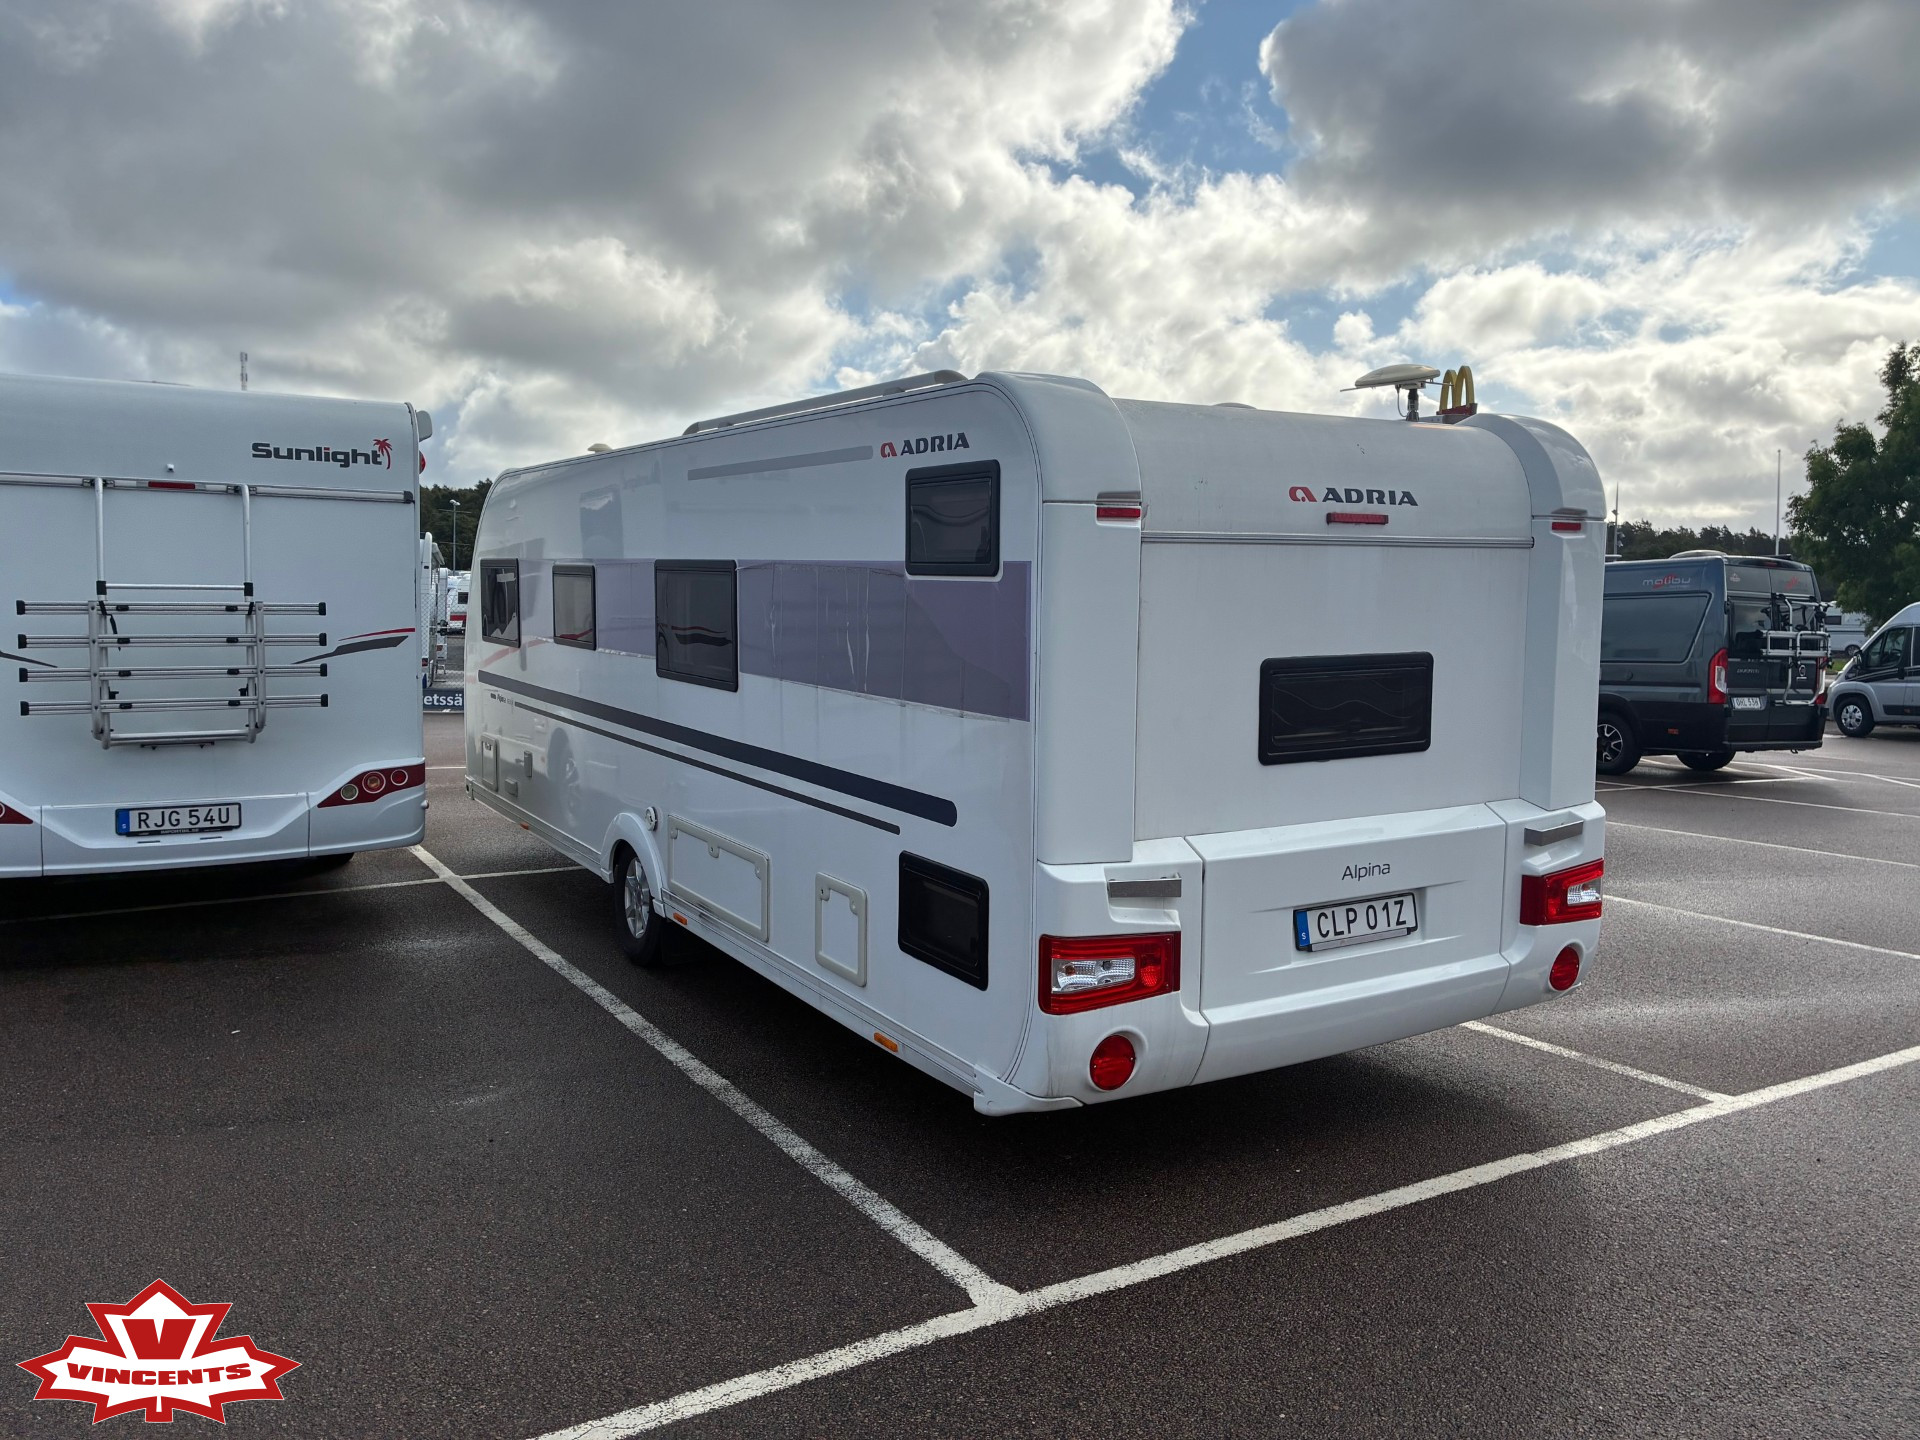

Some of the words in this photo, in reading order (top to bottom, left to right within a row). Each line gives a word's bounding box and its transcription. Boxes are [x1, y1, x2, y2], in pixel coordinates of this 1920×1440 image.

[252, 442, 382, 468] Sunlight
[900, 432, 970, 456] ADRIA
[1322, 487, 1419, 506] ADRIA
[423, 693, 463, 706] etssä
[138, 811, 181, 829] RJG
[188, 807, 230, 826] 54U
[1342, 862, 1391, 882] Alpina
[1301, 932, 1307, 940] S
[1317, 907, 1358, 939] CLP
